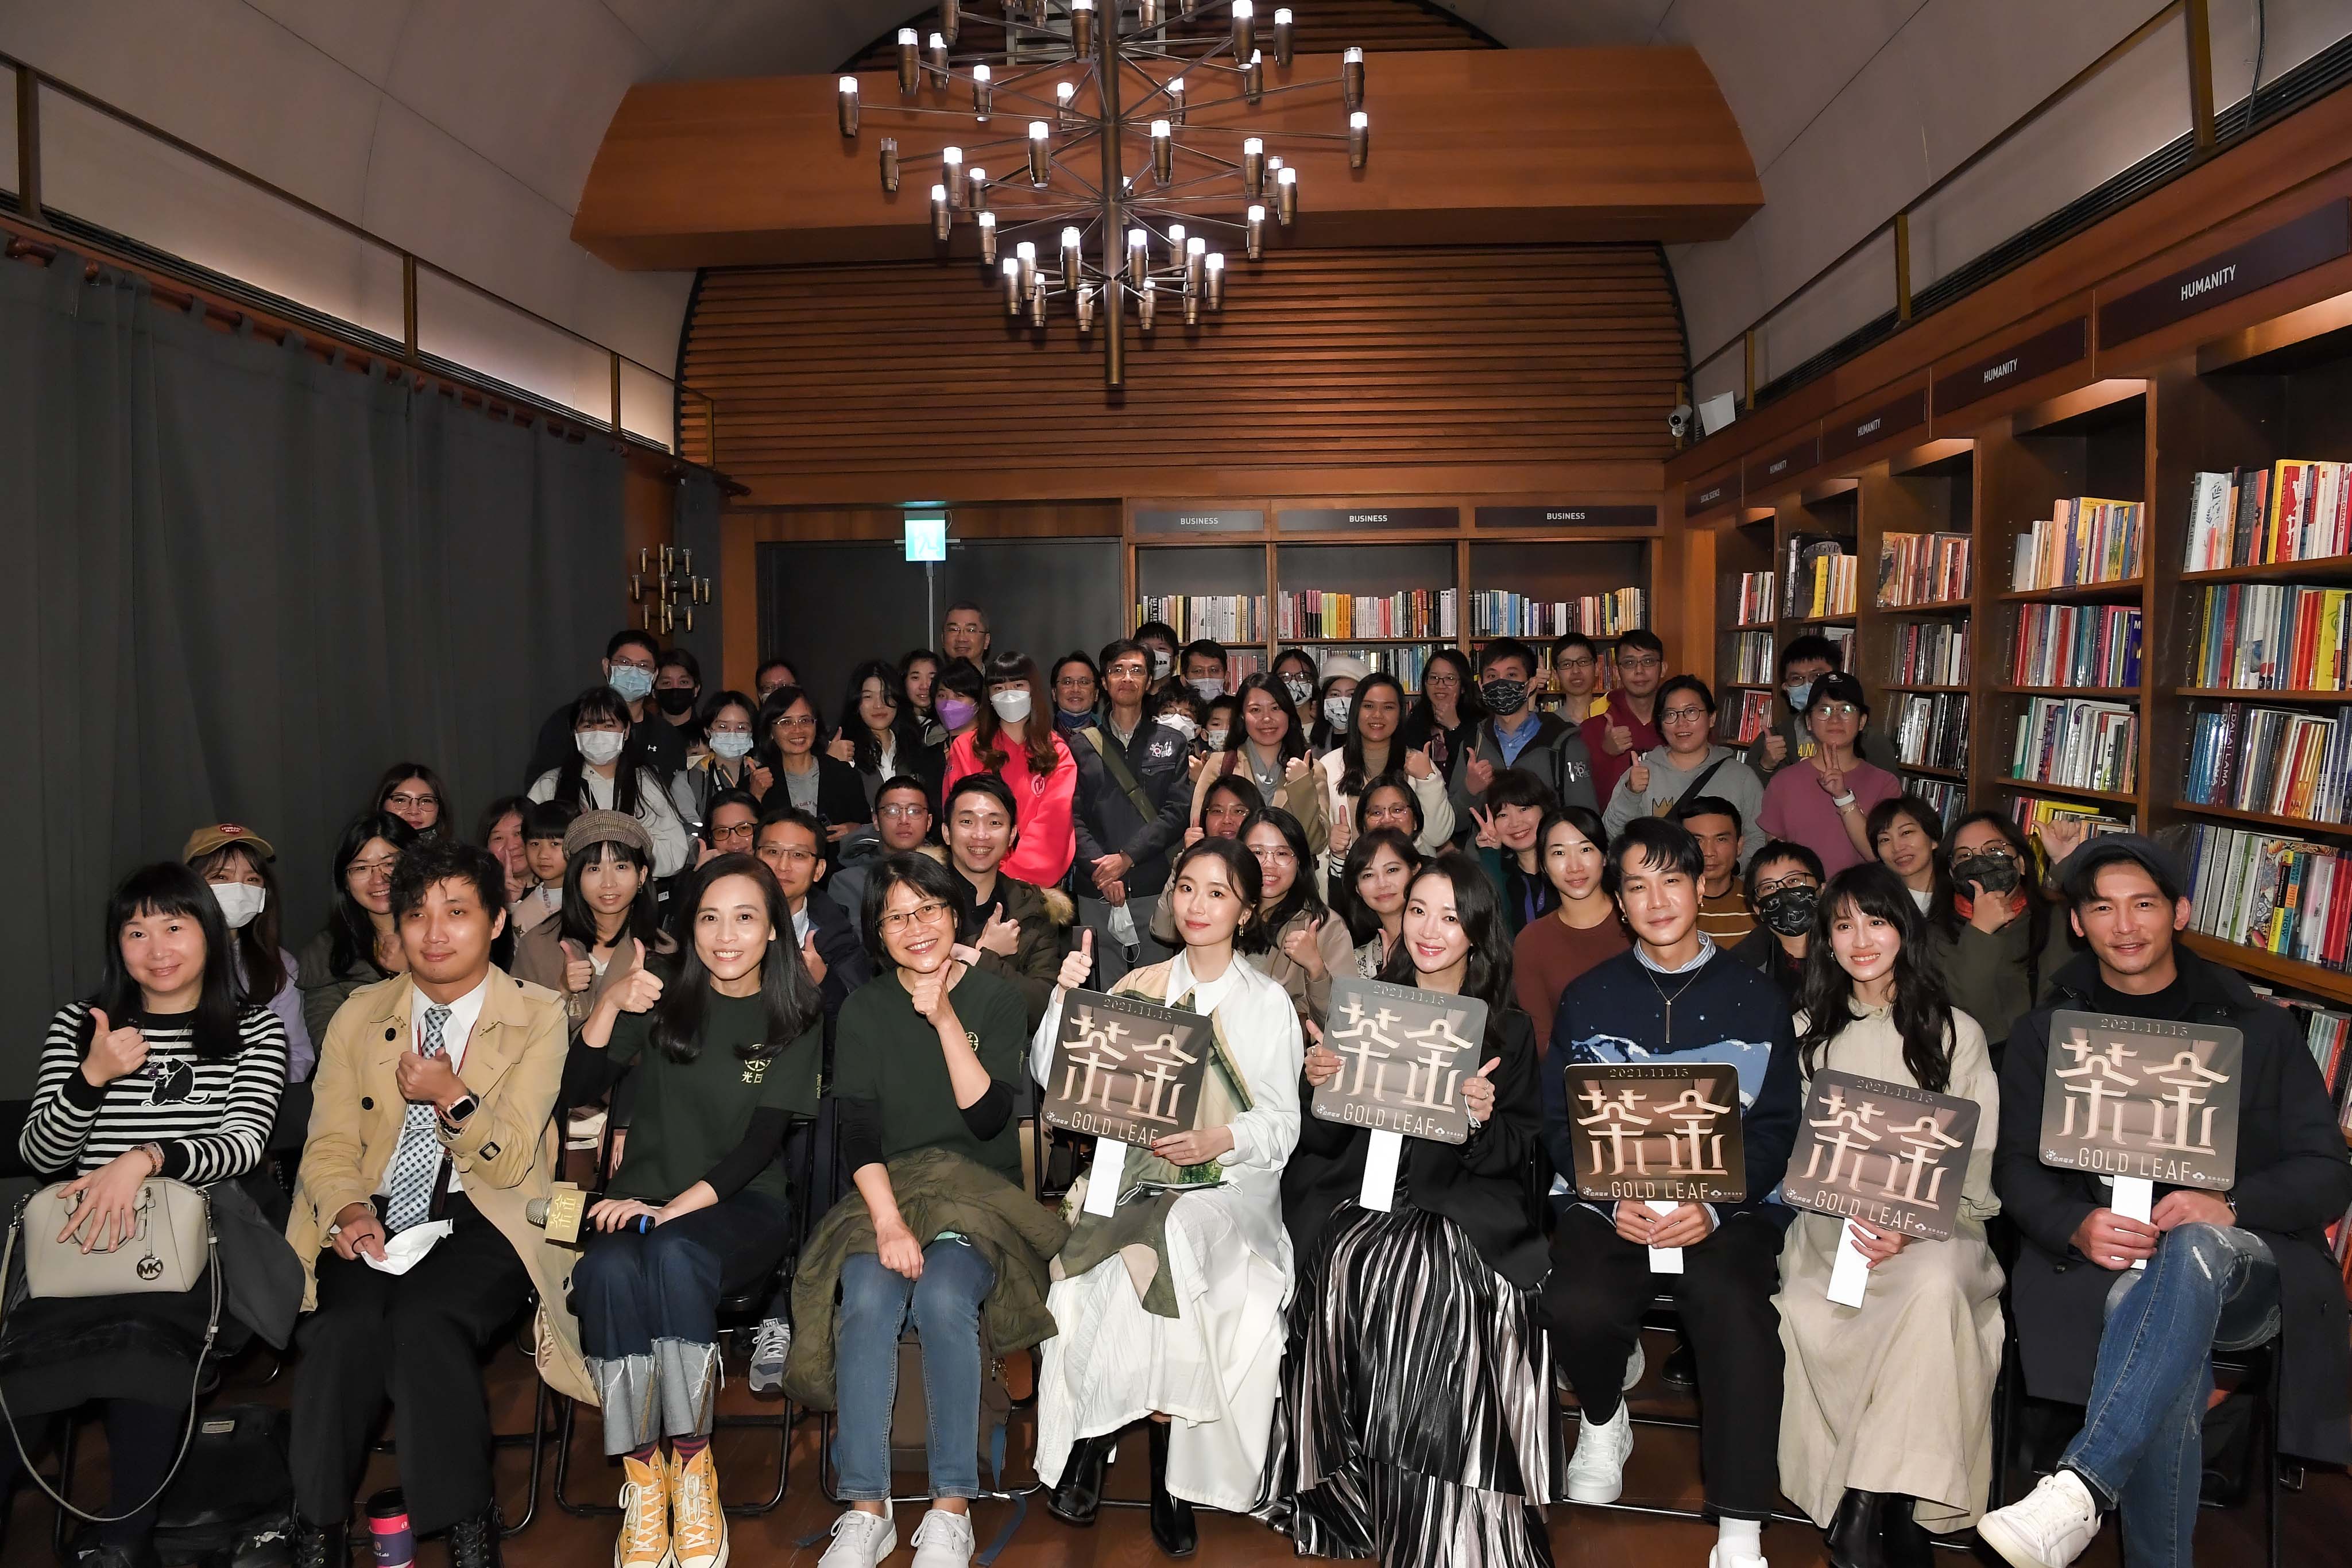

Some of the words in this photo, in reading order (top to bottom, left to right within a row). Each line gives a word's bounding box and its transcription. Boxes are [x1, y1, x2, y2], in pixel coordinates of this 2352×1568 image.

[2181, 264, 2237, 300] HUMANITY
[1984, 358, 2018, 384] HUMANITY
[1858, 418, 1881, 437] HUMANITY
[1769, 460, 1787, 474] HUMANITY
[1709, 488, 1720, 501] SCIENCE
[1349, 515, 1388, 523] BUSINESS
[1546, 512, 1586, 521] BUSINESS
[2227, 714, 2237, 749] DALAI
[2221, 753, 2231, 787] LAMA
[1374, 985, 1445, 1005] 2021.11.15
[1102, 998, 1173, 1020] 2021.11.15
[2100, 1019, 2188, 1036] 2021.11.15
[1057, 1015, 1198, 1125] 茶金
[1328, 1002, 1474, 1113] 茶金
[1610, 1068, 1689, 1077] 2021.11.15
[1856, 1079, 1933, 1103] 2021.11.15
[2055, 1039, 2230, 1156] 茶金
[1071, 1112, 1111, 1135] GOLD
[1118, 1120, 1159, 1145] LEAF
[1344, 1103, 1386, 1126] GOLD
[1393, 1111, 1435, 1135] LEAF
[1577, 1089, 1731, 1175] 茶金
[1800, 1094, 1963, 1210] 茶金
[2079, 1148, 2129, 1172] GOLD
[2140, 1157, 2191, 1181] LEAF
[1611, 1181, 1654, 1198] GOLD
[1665, 1182, 1708, 1199] LEAF
[1815, 1190, 1860, 1216] GOLD
[1869, 1202, 1915, 1230] LEAF
[140, 1262, 160, 1275] MK
